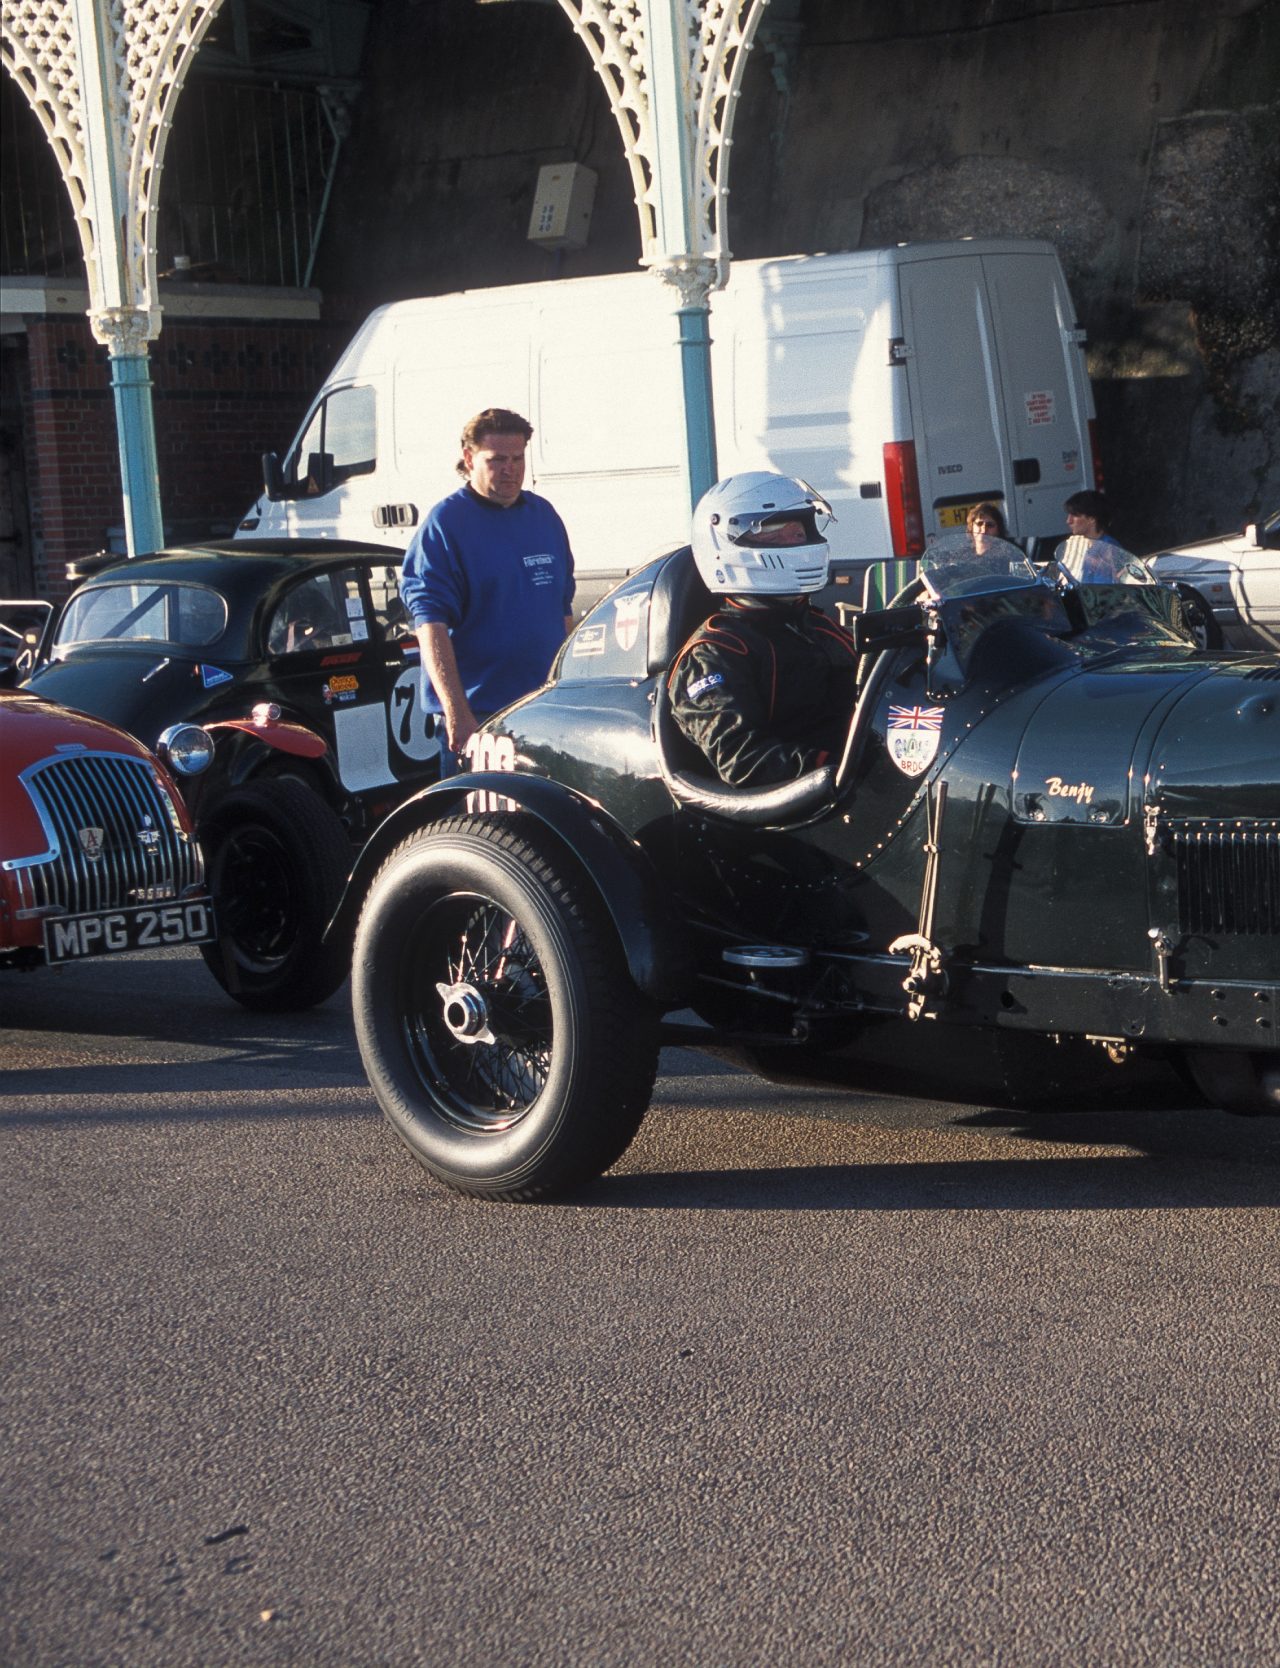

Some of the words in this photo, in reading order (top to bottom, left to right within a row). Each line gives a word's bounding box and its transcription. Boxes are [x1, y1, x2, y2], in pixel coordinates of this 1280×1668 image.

[937, 464, 963, 475] IVECO
[901, 760, 923, 773] BRDC
[1045, 776, 1095, 804] Benjy
[54, 914, 129, 958] MPG
[136, 904, 209, 946] 250
